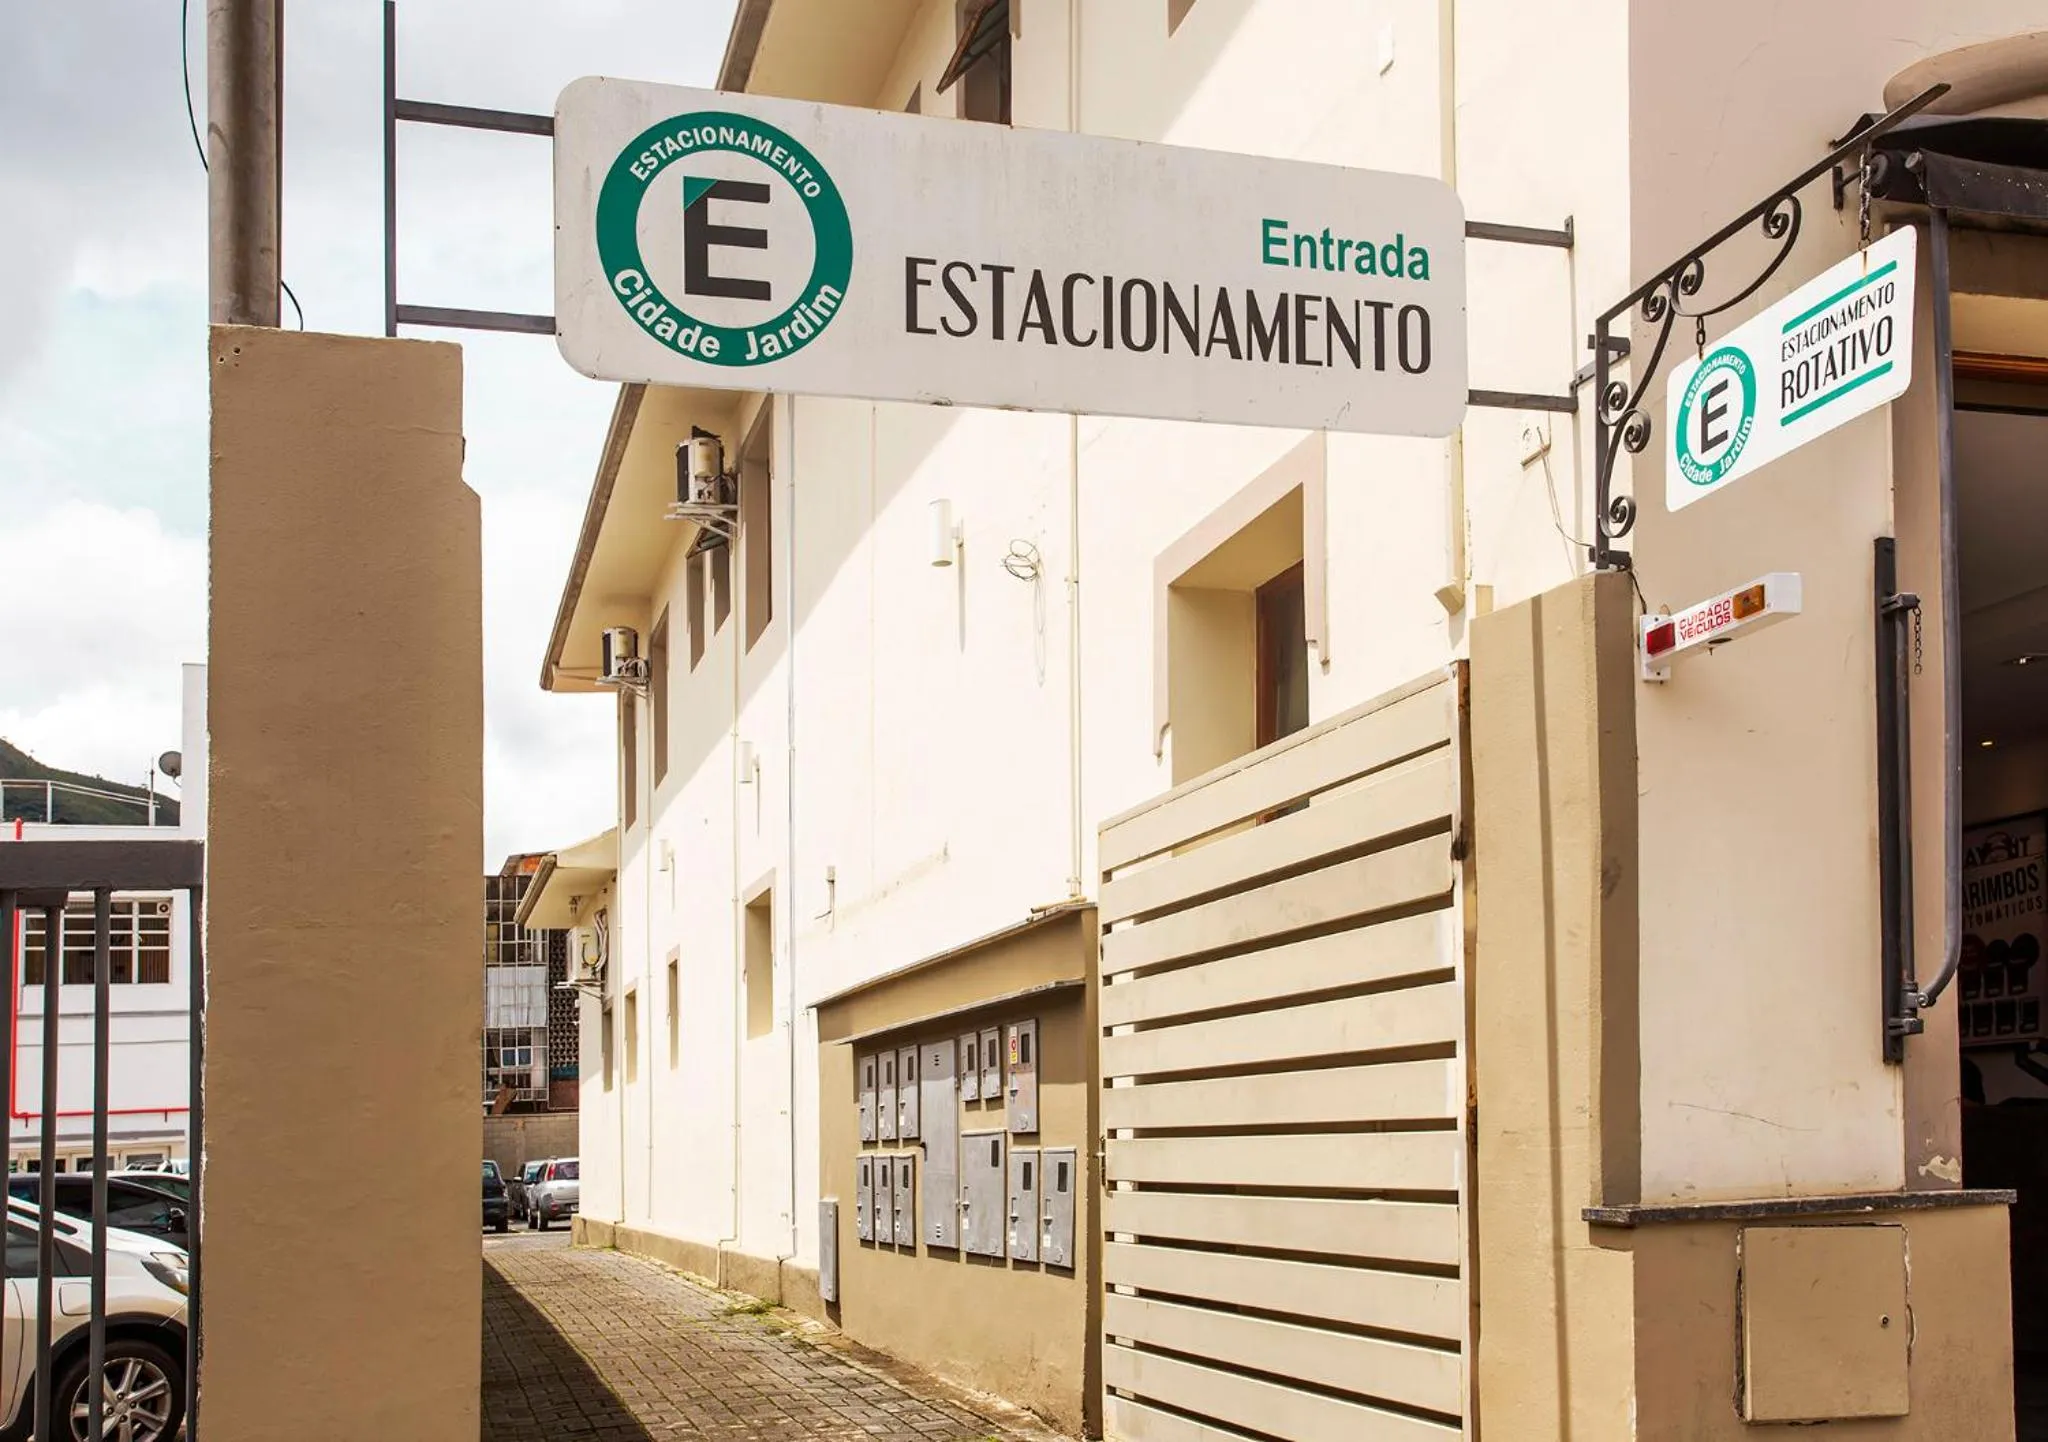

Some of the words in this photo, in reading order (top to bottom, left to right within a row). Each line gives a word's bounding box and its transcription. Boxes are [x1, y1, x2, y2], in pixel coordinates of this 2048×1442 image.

[629, 126, 821, 199] ESTACIONAMENTO
[683, 175, 771, 301] E
[1262, 218, 1430, 281] Entrada
[613, 269, 720, 359] Cidade
[745, 284, 842, 361] Jardim
[905, 256, 1431, 374] ESTACIONAMENTO
[1782, 282, 1894, 362] ESTACIONAMENTO
[1781, 315, 1892, 409] ROTATIVO
[1680, 452, 1713, 482] Cidade
[1720, 416, 1753, 474] Jardim
[1701, 378, 1728, 454] E
[1680, 600, 1730, 629] CUIDADO
[1962, 864, 2039, 910] ARIMBOS
